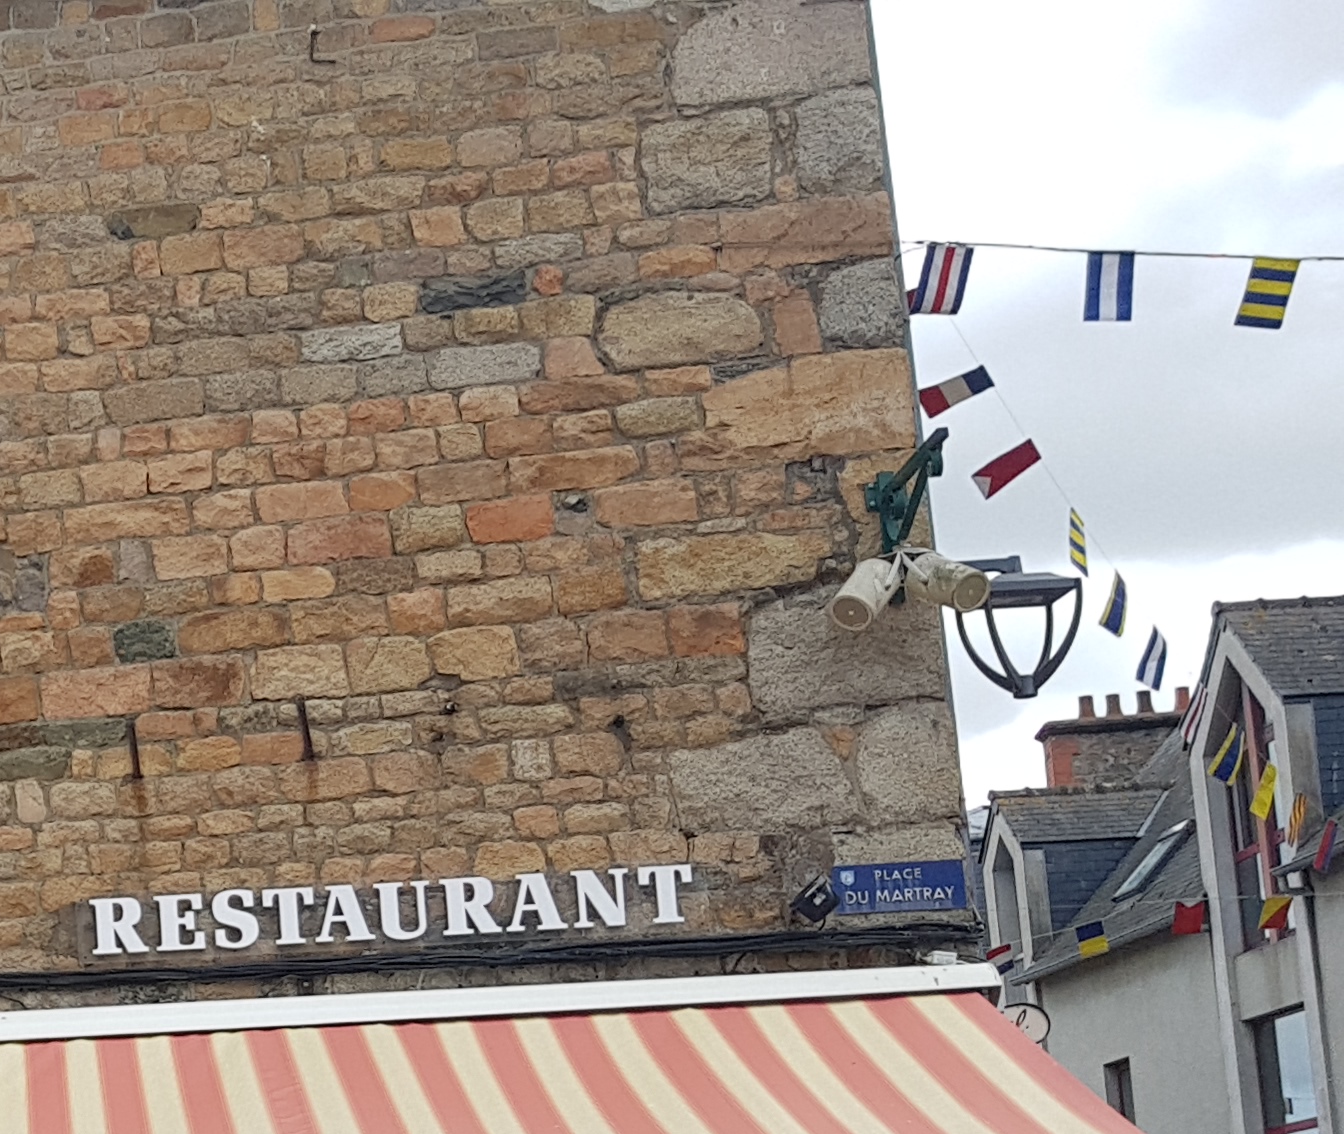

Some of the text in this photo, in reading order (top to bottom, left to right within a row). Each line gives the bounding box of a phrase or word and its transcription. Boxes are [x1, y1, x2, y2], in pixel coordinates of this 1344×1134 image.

[873, 867, 923, 881] PLACE
[845, 885, 955, 905] DU MARTRAY
[88, 864, 693, 955] RESTAURANT
